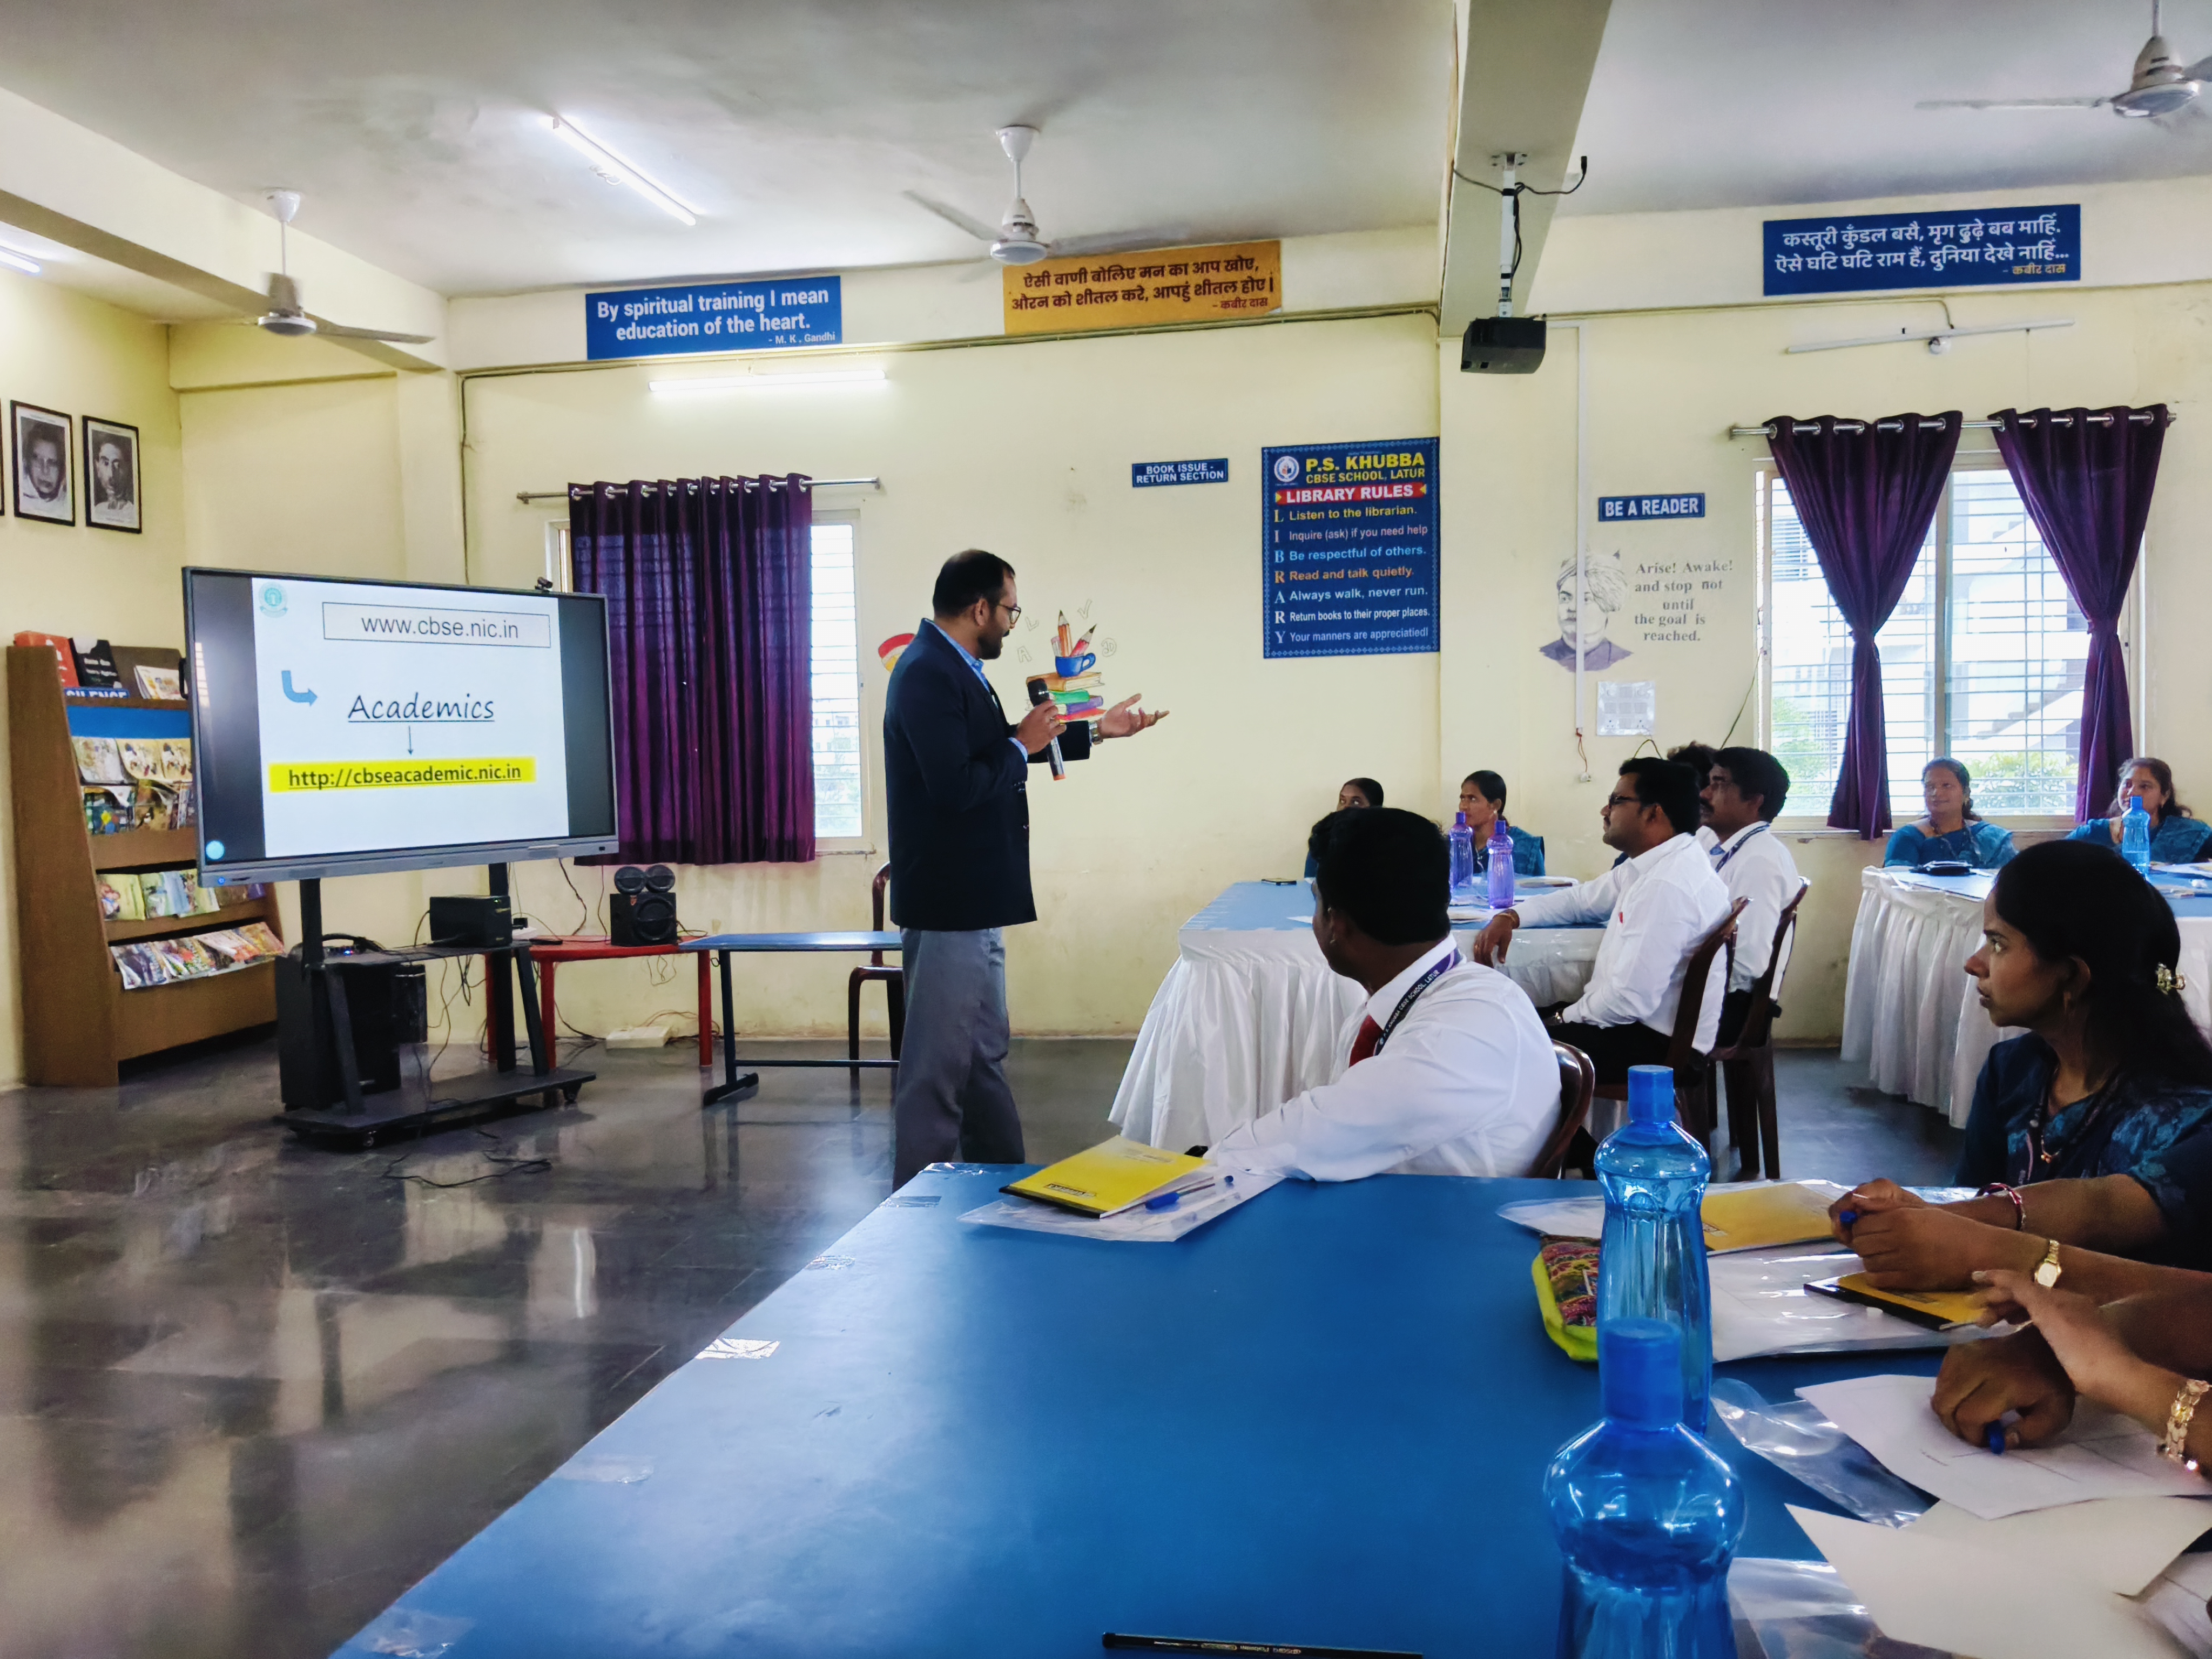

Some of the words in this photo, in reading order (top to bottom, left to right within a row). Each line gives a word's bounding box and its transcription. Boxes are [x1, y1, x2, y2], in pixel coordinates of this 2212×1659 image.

[1783, 226, 1838, 251] कस्तूरी
[1927, 225, 1955, 245] मृग
[1775, 253, 1803, 273] ऐसे
[1806, 251, 1838, 270] घटि
[1840, 249, 1873, 268] घटि
[1876, 252, 1906, 267] राम
[1928, 245, 1981, 271] दुनिया
[1984, 242, 2014, 263] देखे
[1023, 271, 1051, 288] ऐसी
[1054, 267, 1088, 285] वाणी
[1091, 265, 1136, 282] बोलिए
[1139, 265, 1165, 278] मन
[1168, 263, 1189, 276] का
[1193, 260, 1220, 274] आप
[1224, 255, 1259, 272] खोए,
[2012, 263, 2042, 275] कबीर
[2045, 264, 2066, 273] दास
[1052, 291, 1071, 307] को
[1076, 288, 1118, 305] शीतल
[1122, 285, 1149, 302] करे,
[1194, 279, 1238, 295] शीतल
[597, 301, 618, 322] By
[624, 294, 693, 320] spiritual
[699, 291, 764, 312] training
[771, 290, 775, 306] I
[781, 289, 828, 306] mean
[1220, 298, 1247, 309] कबीर
[1249, 297, 1269, 307] दास
[616, 319, 698, 341] education
[704, 316, 721, 334] of
[727, 315, 754, 332] the
[760, 312, 810, 331] heart.
[775, 335, 787, 344] M.
[804, 331, 835, 342] Gandhi
[1146, 465, 1175, 475] BOOK
[1178, 463, 1208, 473] ISSUE
[1306, 457, 1339, 472] P.S.
[1346, 453, 1425, 470] KHUBBA
[1136, 474, 1177, 483] RETURN
[1180, 470, 1224, 481] SECTION
[1306, 474, 1336, 484] CBSE
[1391, 468, 1425, 479] LATUR
[1286, 488, 1355, 503] LIBRARY
[1360, 485, 1413, 499] RULES
[1274, 510, 1284, 522] L
[1289, 511, 1325, 521] Listen
[1328, 510, 1339, 519] to
[1343, 509, 1361, 518] the
[1365, 507, 1417, 517] librarian.
[1605, 501, 1623, 517] BE
[1628, 500, 1637, 516] A
[1642, 497, 1698, 515] READER
[1274, 530, 1279, 543] I
[1289, 531, 1322, 542] Inquire
[1325, 529, 1348, 541] (ask)
[1351, 528, 1357, 537] if
[1360, 529, 1378, 538] you
[1381, 527, 1404, 536] need
[1407, 524, 1428, 535] help
[1274, 550, 1284, 563] B
[1290, 551, 1304, 561] Be
[1309, 548, 1366, 561] respectful
[1370, 547, 1382, 557] of
[1385, 546, 1426, 556] others.
[1636, 563, 1676, 574] Arise!
[1682, 560, 1732, 572] Awake!
[1274, 570, 1285, 583] R
[1290, 570, 1319, 581] Read
[1323, 569, 1344, 579] and
[1348, 568, 1368, 578] talk
[1274, 591, 1285, 603] A
[1290, 591, 1331, 602] Always
[1335, 589, 1364, 599] walk,
[1368, 589, 1401, 598] never
[1405, 586, 1428, 596] run.
[1635, 581, 1659, 592] and
[1664, 581, 1692, 594] stop
[1702, 579, 1723, 590] not
[1663, 598, 1694, 610] until
[1274, 611, 1286, 624] R
[1290, 612, 1316, 622] Return
[1318, 610, 1342, 621] books
[1344, 611, 1352, 619] to
[1354, 609, 1371, 619] their
[1374, 609, 1400, 621] proper
[1402, 608, 1430, 619] places.
[1634, 613, 1655, 624] the
[1659, 614, 1687, 627] goal
[1696, 613, 1705, 625] is
[361, 617, 518, 639] www.cbse.nic.in
[1644, 630, 1701, 641] reached.
[1274, 631, 1285, 644] Y
[1290, 632, 1310, 642] Your
[1312, 631, 1351, 641] manners
[1353, 631, 1368, 639] are
[348, 692, 495, 719] Academics
[288, 764, 521, 790] http://cbseacademic.nic.in
[1425, 969, 1440, 983] LATUR
